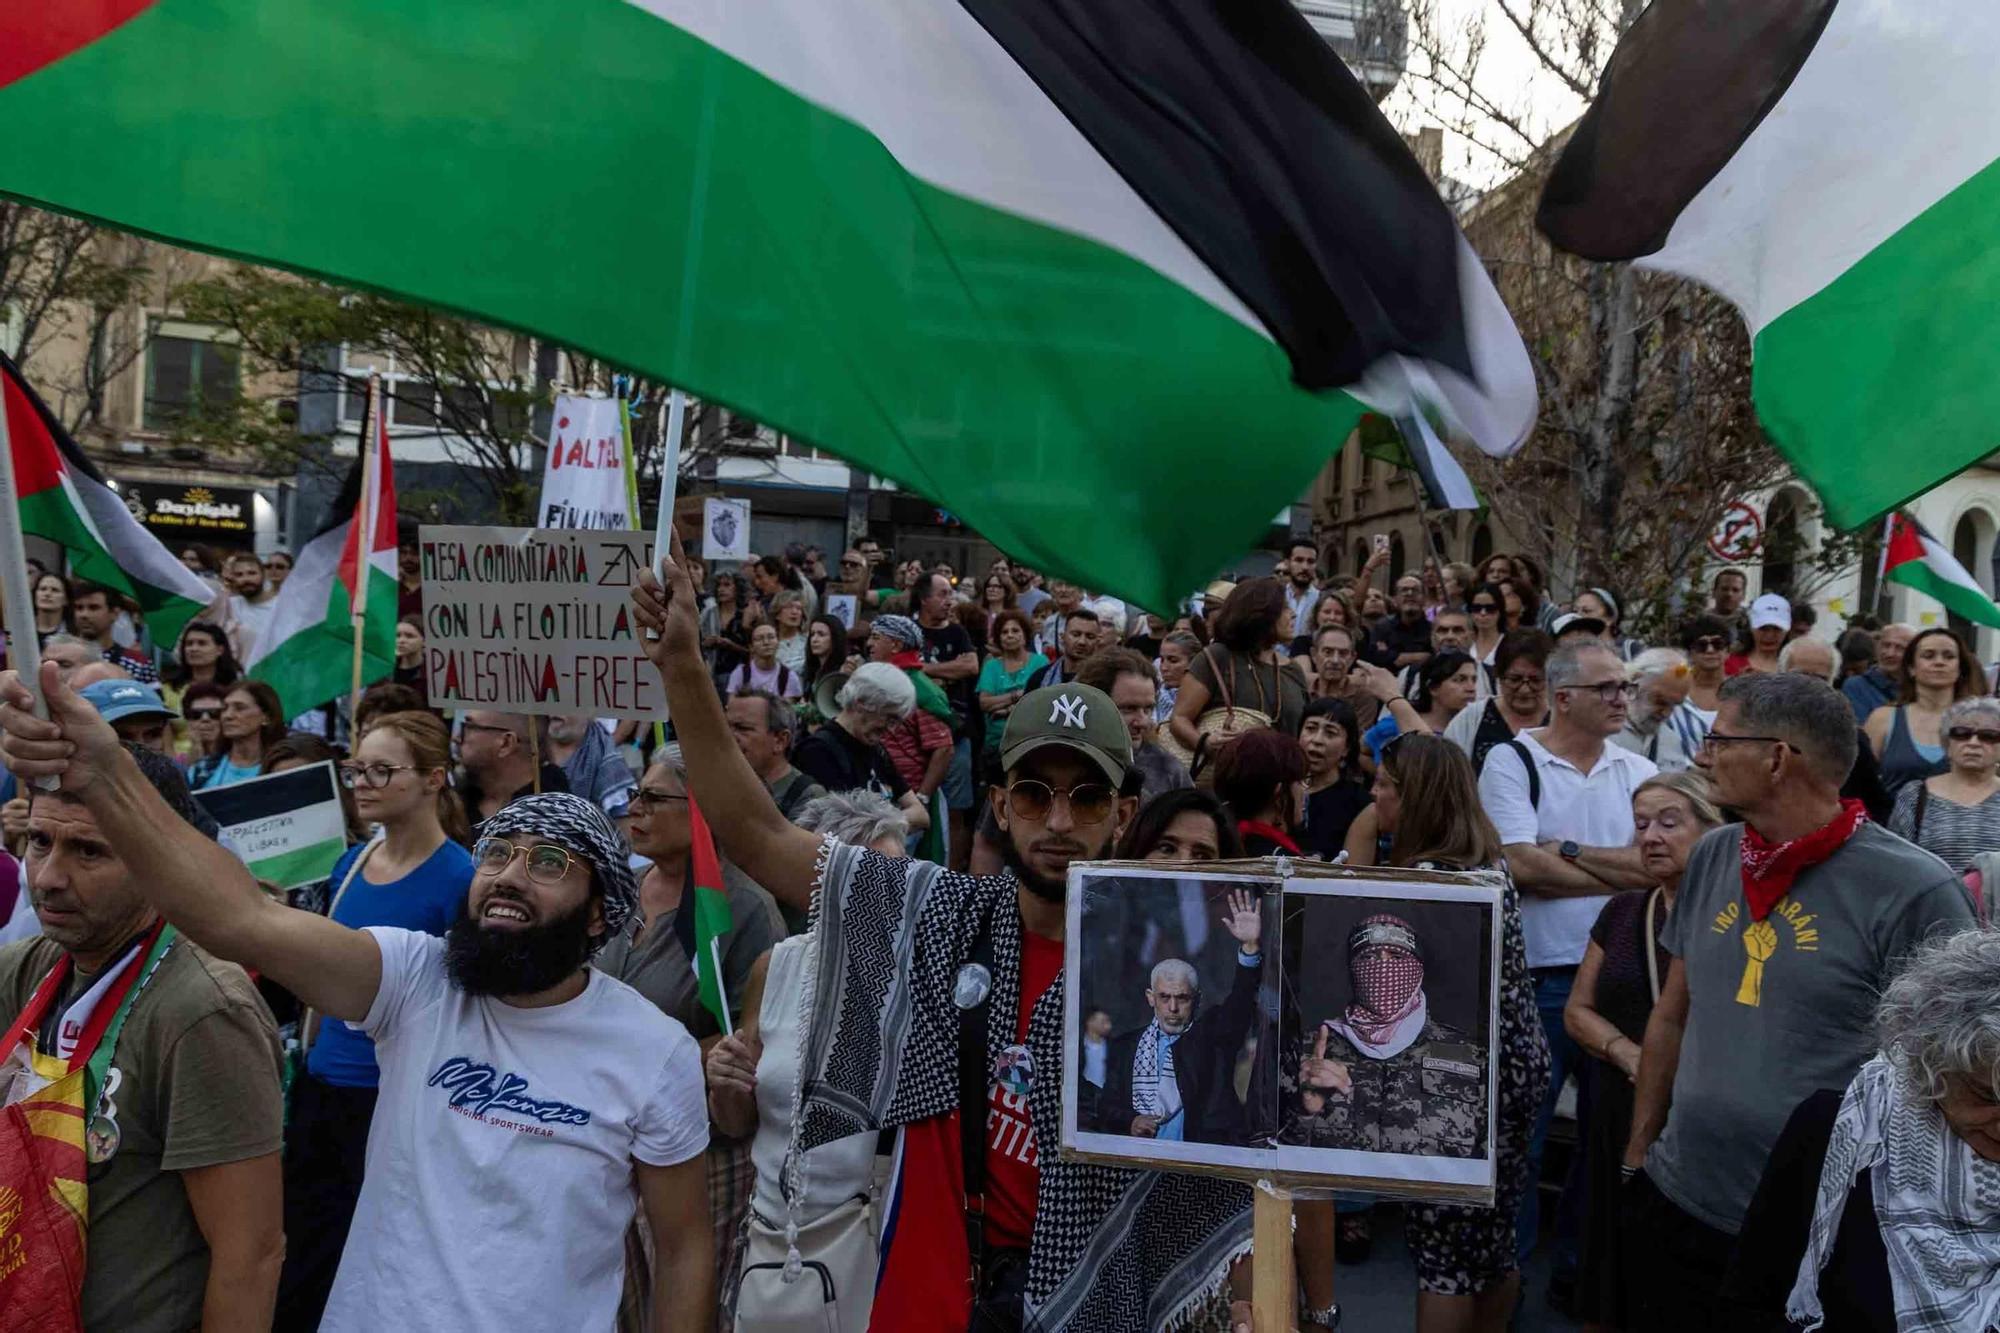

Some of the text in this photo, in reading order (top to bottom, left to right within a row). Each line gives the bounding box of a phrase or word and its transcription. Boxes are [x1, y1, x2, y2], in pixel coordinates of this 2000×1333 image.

[154, 499, 241, 518] Daylight
[422, 542, 471, 582] MESA
[473, 537, 589, 584] COMUNITARIA
[428, 597, 632, 641] CON LA FLOTILLA
[429, 1060, 591, 1126] McKenzie
[448, 1104, 554, 1138] ORIGINAL SPORTSWEAR
